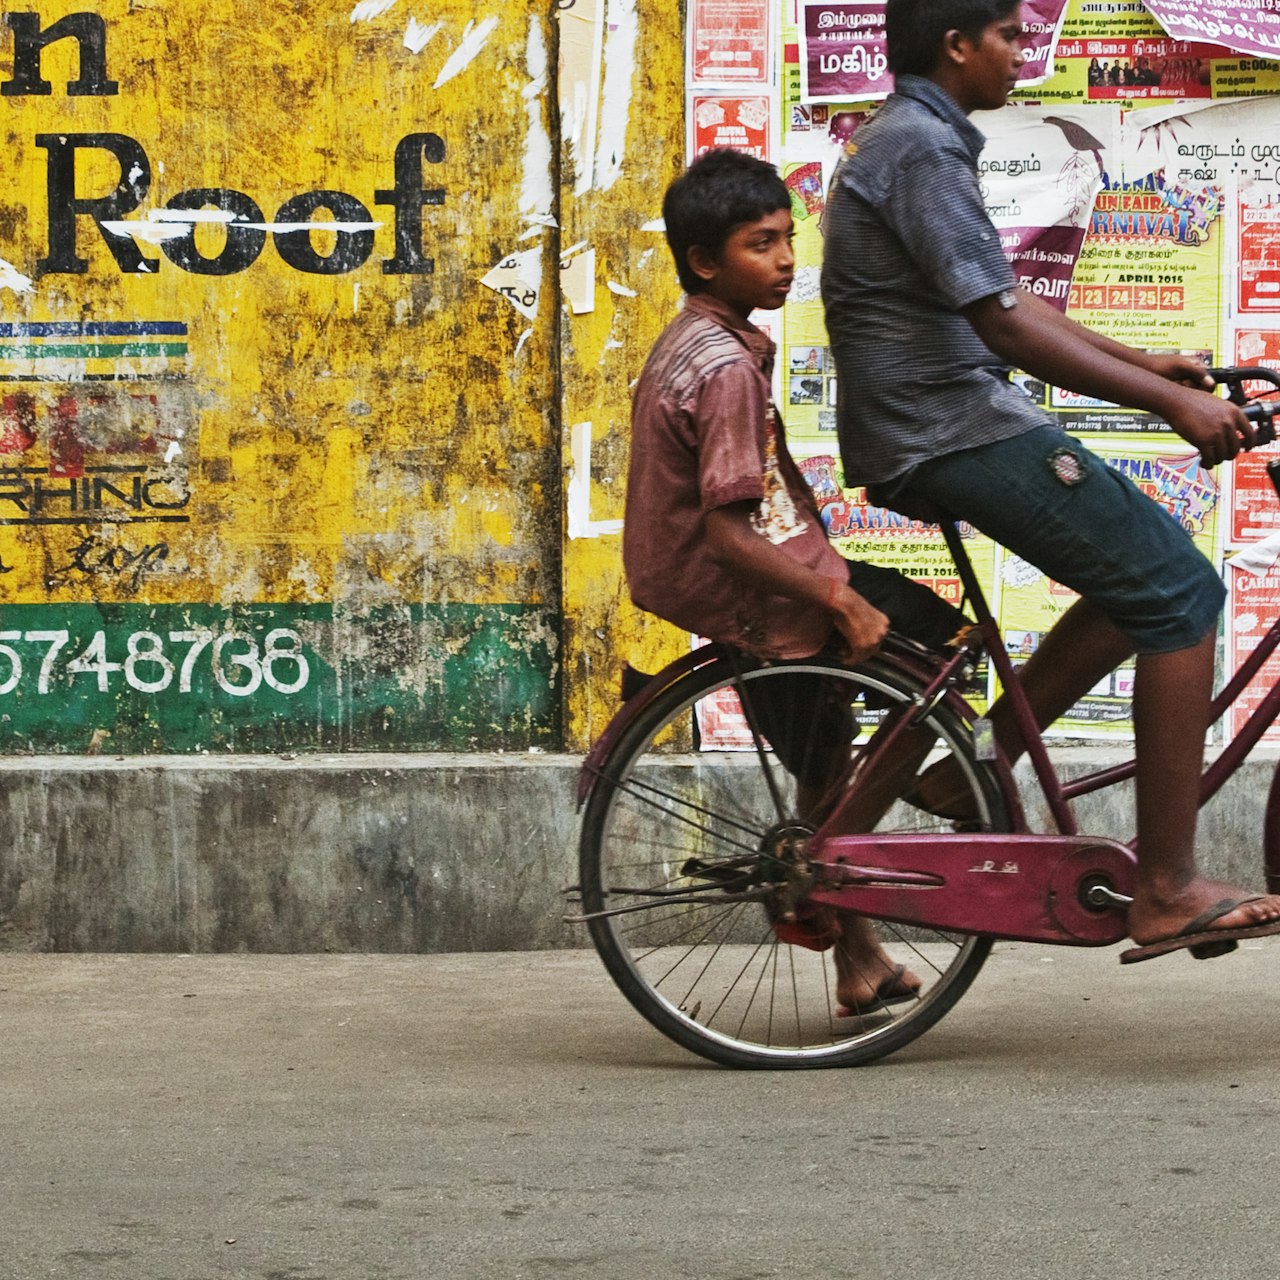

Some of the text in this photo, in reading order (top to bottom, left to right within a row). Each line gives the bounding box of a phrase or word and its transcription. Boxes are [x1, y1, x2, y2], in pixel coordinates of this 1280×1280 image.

[1178, 137, 1245, 160] வருடம்
[35, 133, 446, 275] Roof
[1123, 194, 1163, 210] FAIR
[1118, 274, 1183, 283] APRIL 2015
[1085, 290, 1103, 305] 23
[901, 568, 959, 576] PRIL 2015
[938, 584, 956, 599] 26
